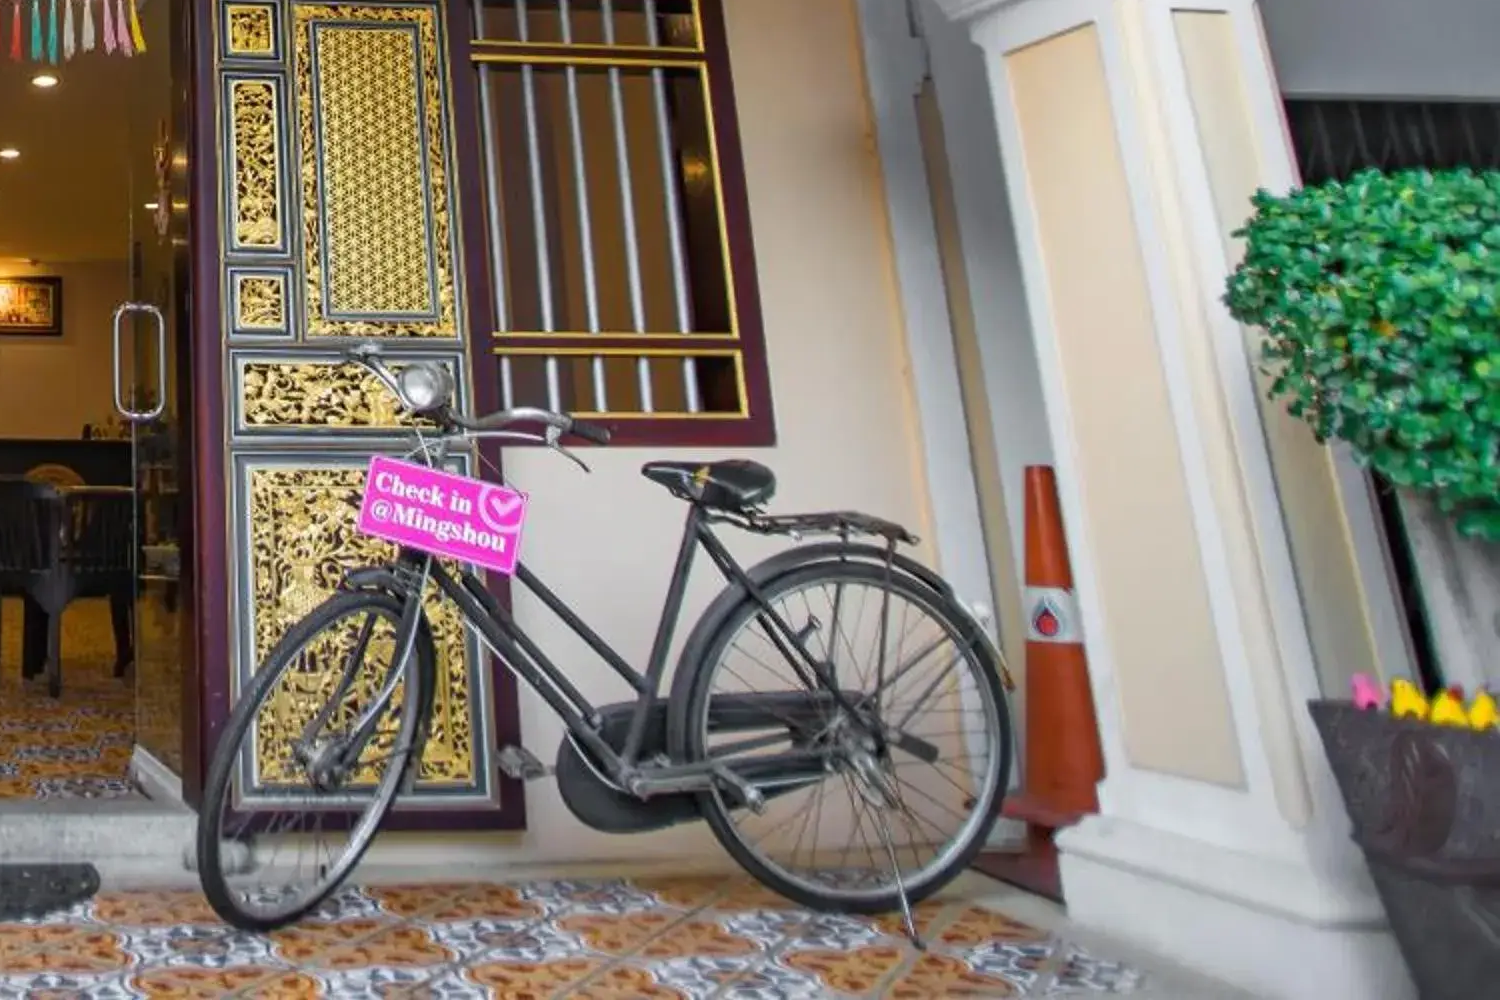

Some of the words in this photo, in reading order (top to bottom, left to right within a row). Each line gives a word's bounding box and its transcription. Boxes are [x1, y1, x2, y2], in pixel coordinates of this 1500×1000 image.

[375, 472, 446, 508] Check
[449, 489, 473, 516] in
[370, 498, 506, 553] @Mingshou
